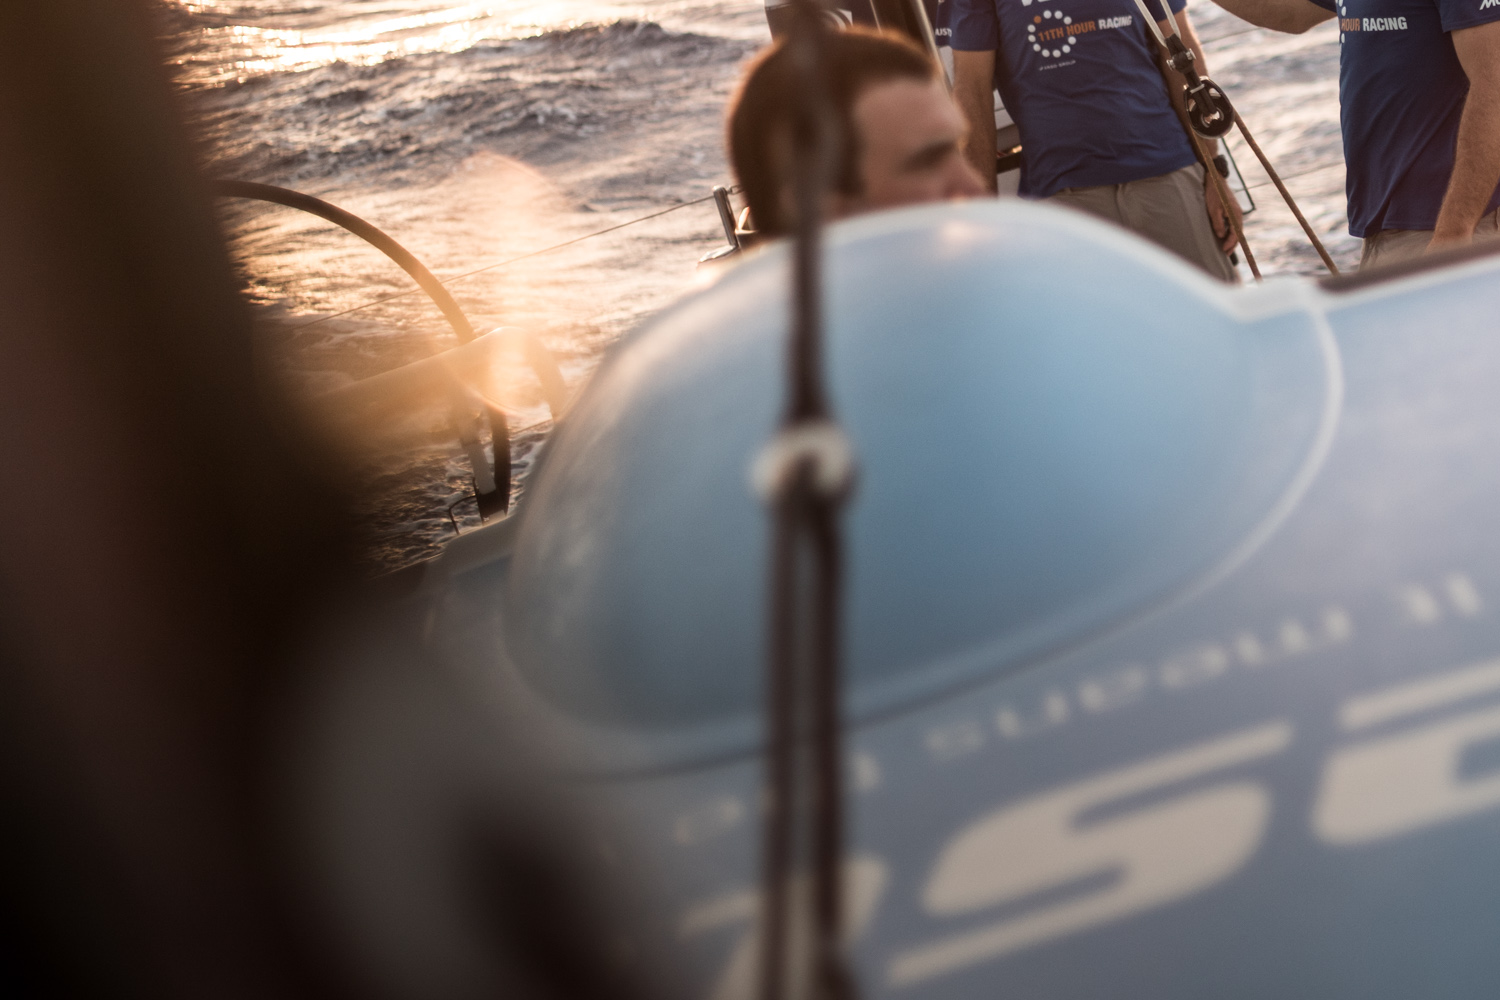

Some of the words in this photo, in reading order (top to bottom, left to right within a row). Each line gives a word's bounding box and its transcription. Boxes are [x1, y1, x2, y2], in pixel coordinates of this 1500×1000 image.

[1038, 28, 1064, 42] 11TH
[1066, 20, 1096, 36] HOUR
[1098, 15, 1133, 30] RACING
[1341, 18, 1360, 32] HOUR
[1362, 16, 1408, 32] RACING
